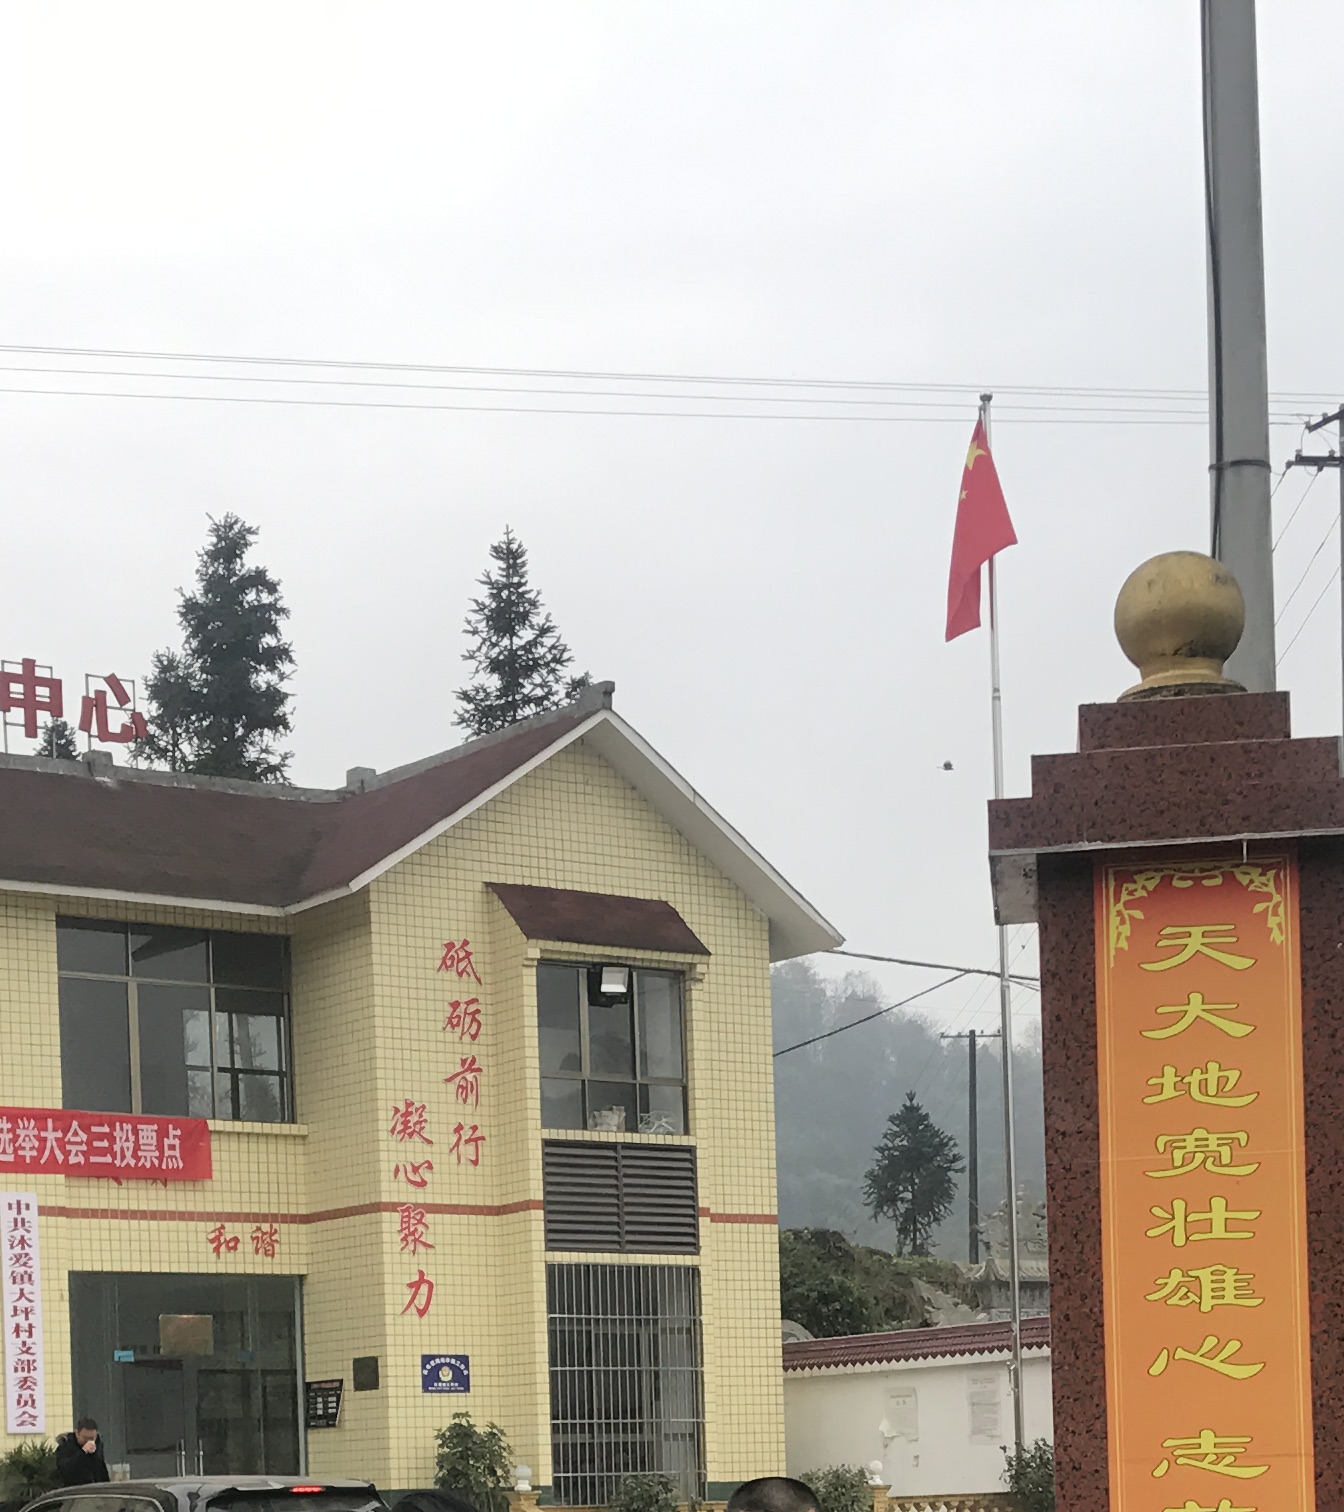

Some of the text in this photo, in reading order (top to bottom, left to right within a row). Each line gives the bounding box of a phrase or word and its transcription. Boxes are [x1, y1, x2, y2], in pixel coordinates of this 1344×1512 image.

[436, 937, 487, 1168] 砥砺前行
[7, 1198, 39, 1428] 中共沐爱镇大坪村支部委员会
[206, 1223, 281, 1260] 和谐
[388, 1098, 435, 1319] 凝心聚力
